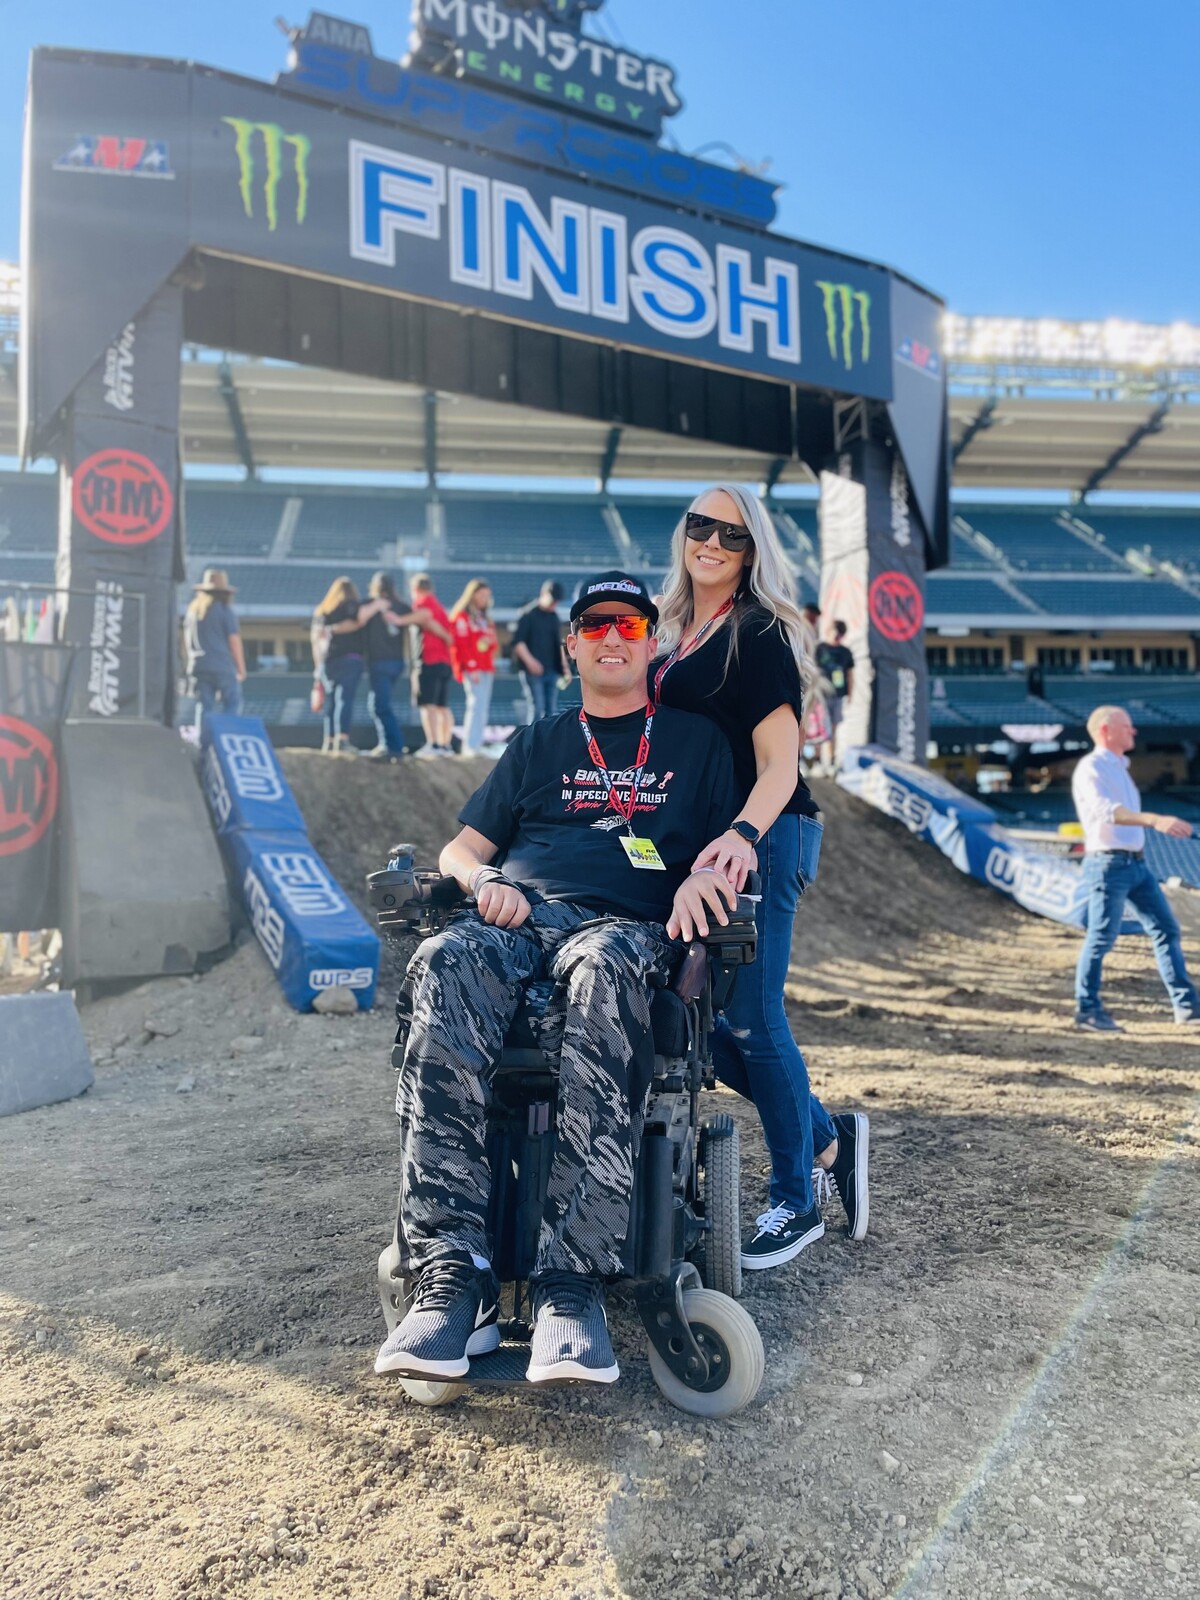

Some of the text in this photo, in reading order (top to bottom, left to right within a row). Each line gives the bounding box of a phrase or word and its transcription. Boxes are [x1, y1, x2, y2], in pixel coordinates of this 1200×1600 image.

[309, 16, 373, 56] AMA
[466, 50, 645, 121] ENERGY
[296, 42, 777, 222] SUPERCROSS
[349, 138, 801, 364] FINISH
[220, 733, 284, 801] WPS
[561, 789, 573, 800] IN
[575, 791, 609, 801] SPEED
[635, 792, 669, 804] TRUST
[260, 852, 347, 917] WPS
[985, 846, 1077, 916] WPS
[309, 966, 374, 991] WPS
